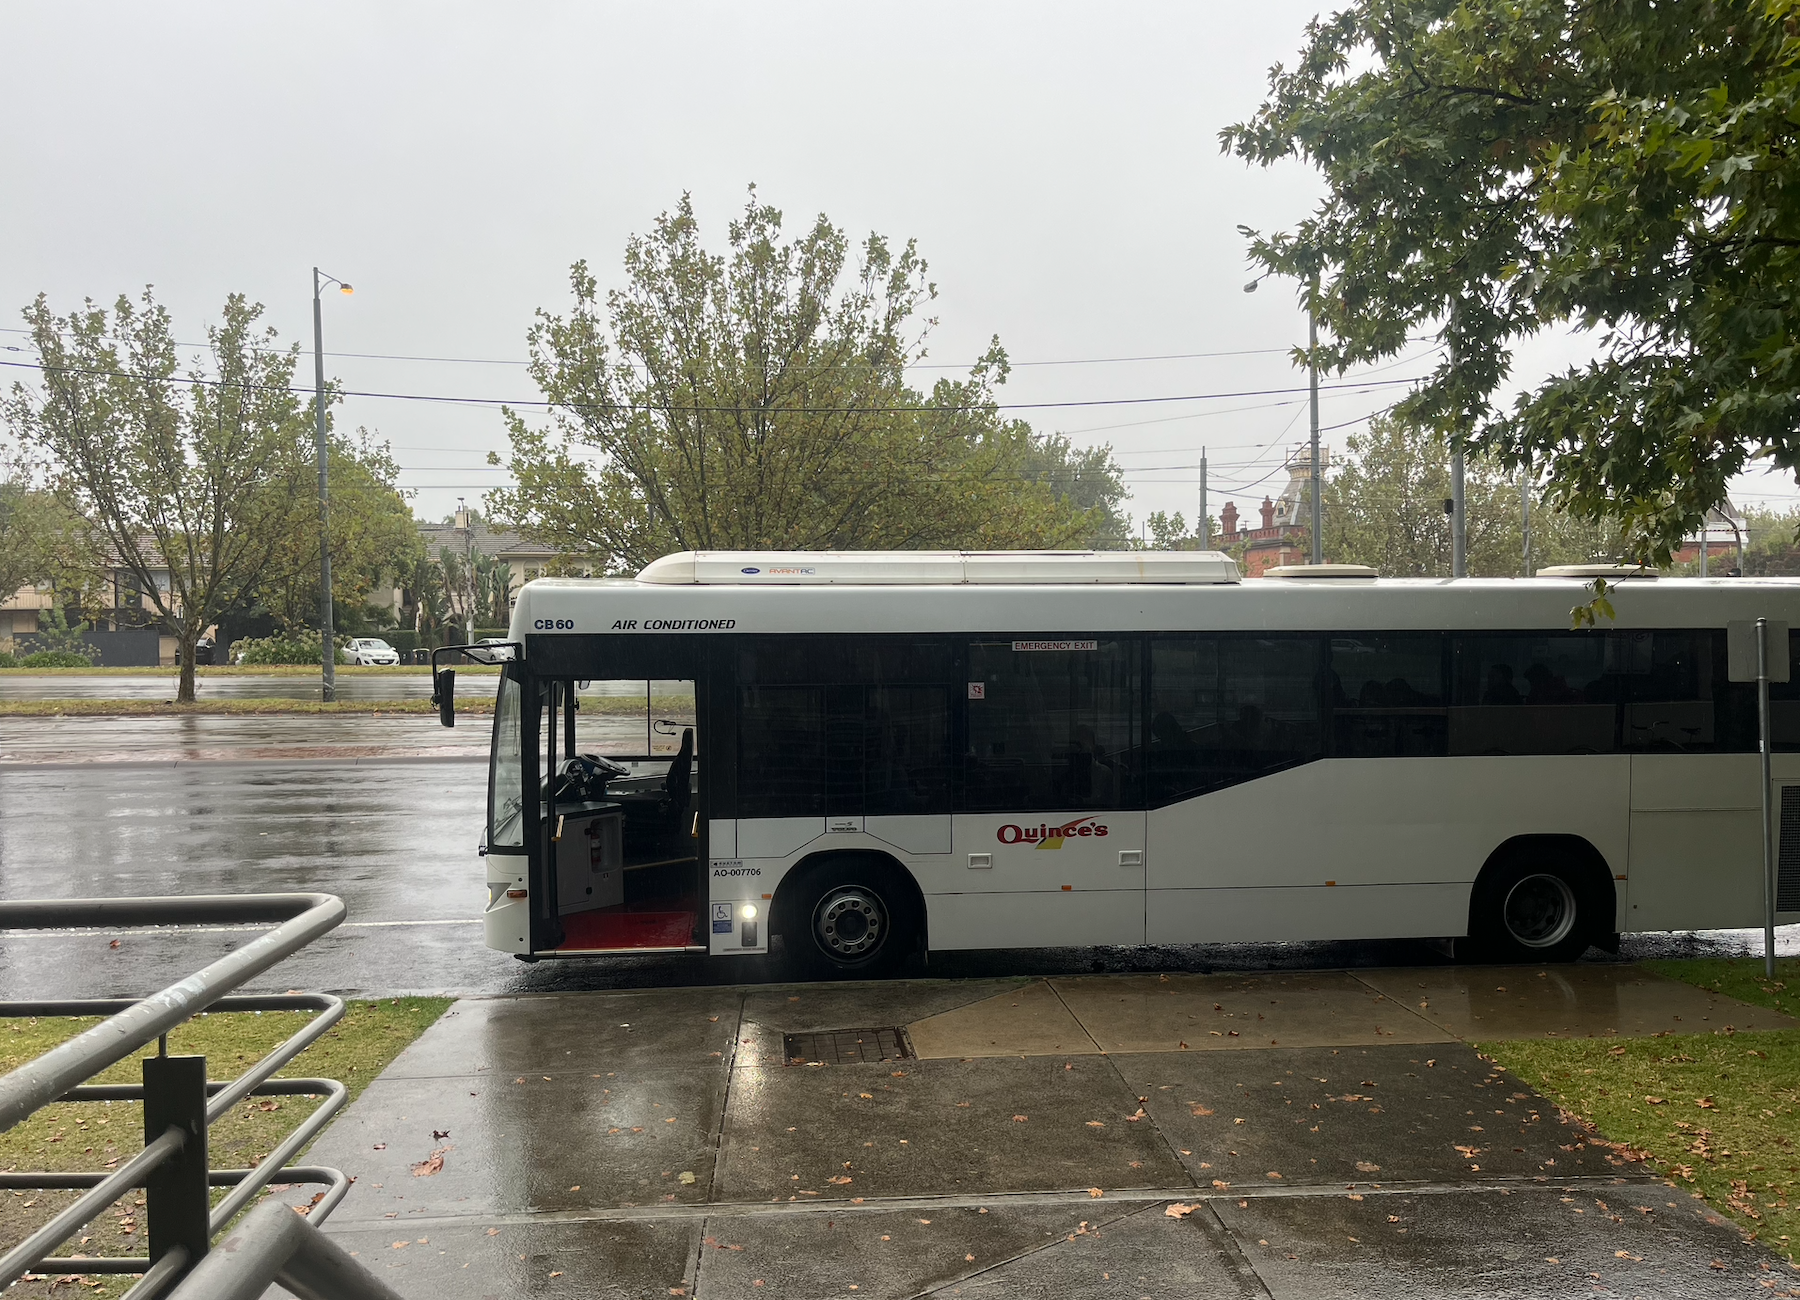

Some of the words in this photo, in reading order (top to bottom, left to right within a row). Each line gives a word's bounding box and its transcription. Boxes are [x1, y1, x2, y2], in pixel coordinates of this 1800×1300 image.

[534, 619, 575, 630] CB60
[611, 619, 638, 630] AIR
[643, 619, 736, 630] CONDITIONED
[1015, 642, 1071, 650] EMERGENCY
[1074, 641, 1094, 650] EXIT
[997, 822, 1109, 844] Quince's
[713, 868, 761, 877] AO-007706
